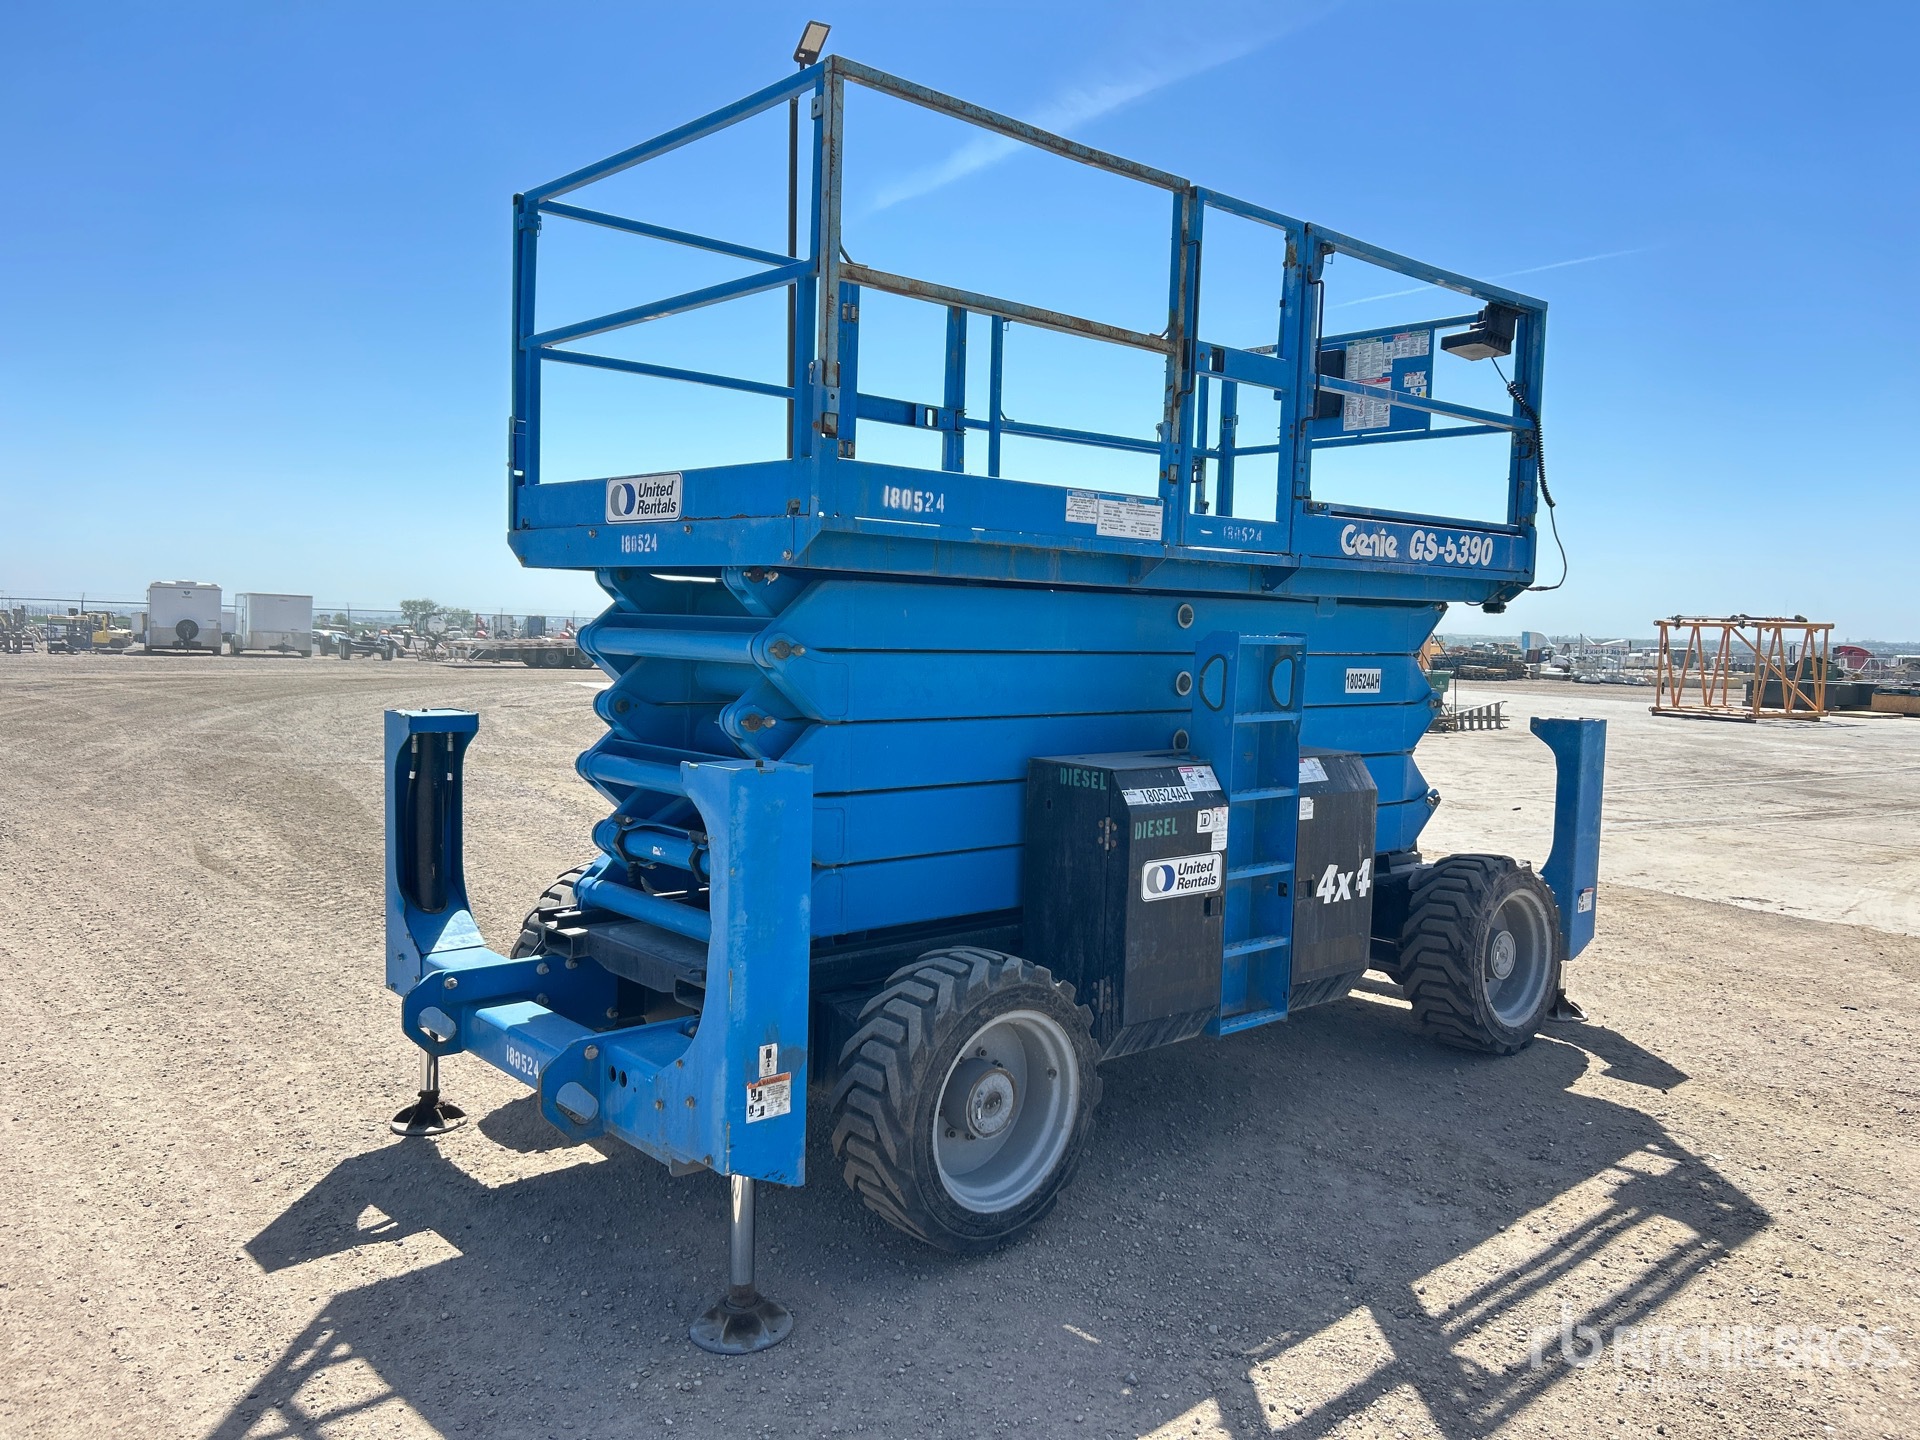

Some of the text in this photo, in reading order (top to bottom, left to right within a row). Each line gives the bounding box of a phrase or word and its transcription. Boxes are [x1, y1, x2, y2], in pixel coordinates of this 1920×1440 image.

[638, 480, 675, 498] United
[883, 485, 945, 513] 180524
[637, 498, 677, 515] Rentals
[621, 533, 658, 553] 180524
[1340, 524, 1494, 566] Genie GS-5390
[1346, 672, 1381, 690] 180524AH
[1060, 767, 1107, 791] DIESEL
[1139, 786, 1192, 803] 180524AH
[1134, 818, 1178, 840] DIESEL
[1177, 859, 1215, 876] United
[1176, 873, 1217, 890] Rentals
[1316, 858, 1372, 905] 4x4
[506, 1044, 539, 1079] 180524
